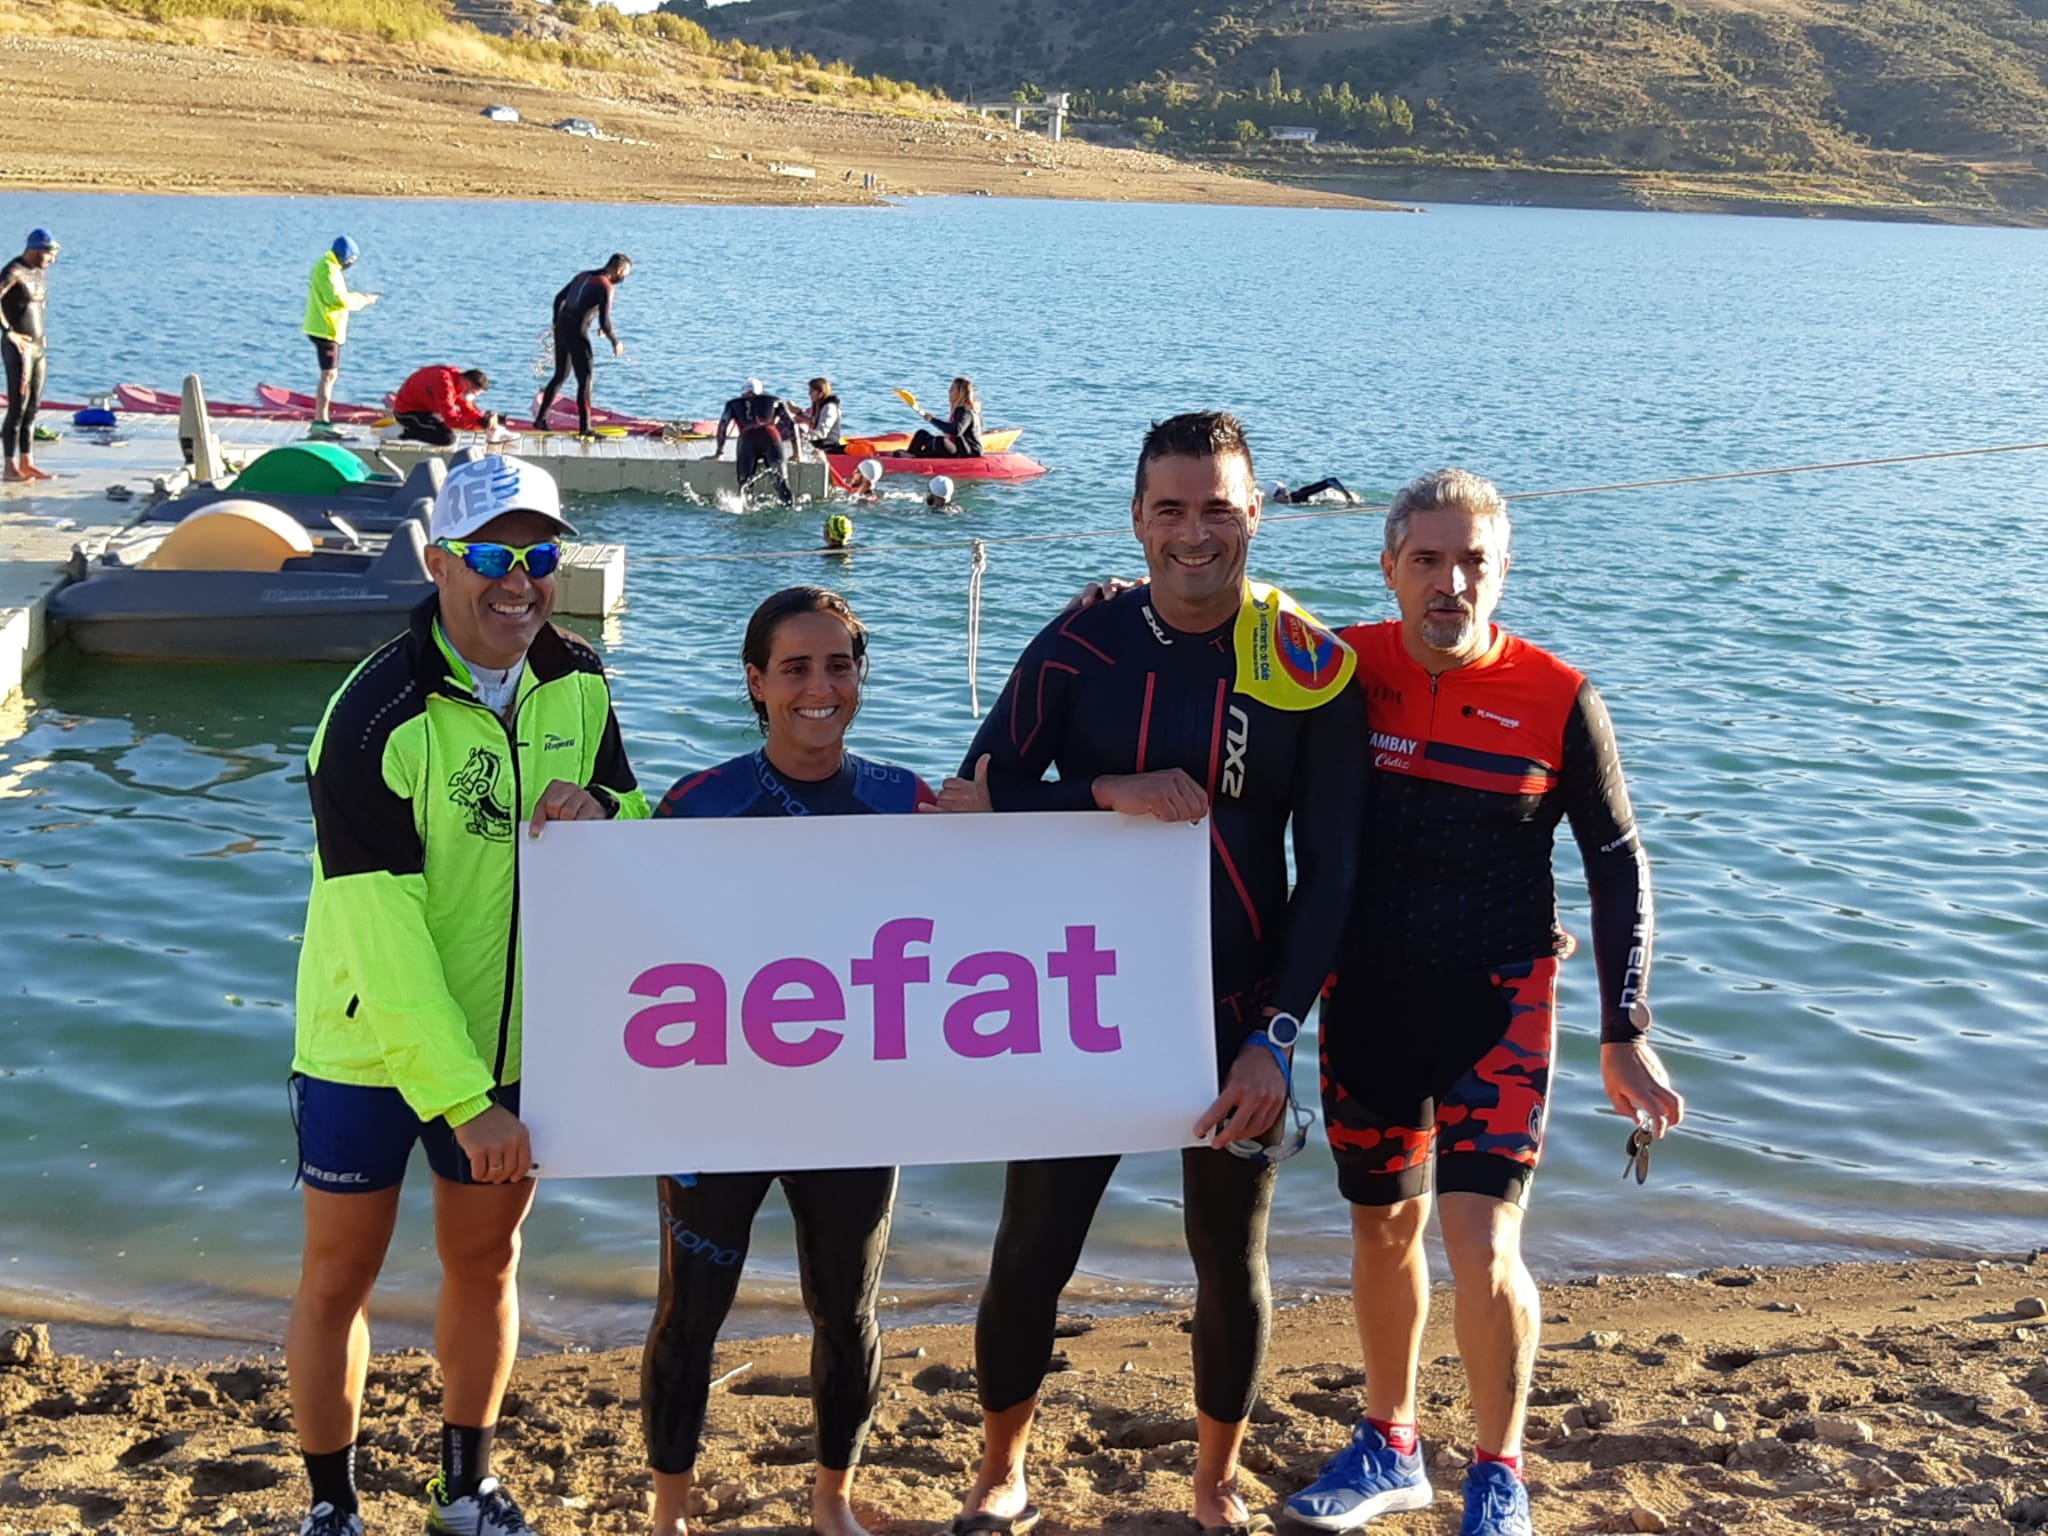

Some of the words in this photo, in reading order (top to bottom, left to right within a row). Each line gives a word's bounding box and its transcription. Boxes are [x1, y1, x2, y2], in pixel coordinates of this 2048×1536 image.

[1221, 705, 1249, 799] 2XU
[1368, 730, 1418, 755] AMBAY
[623, 917, 1122, 1068] aefat
